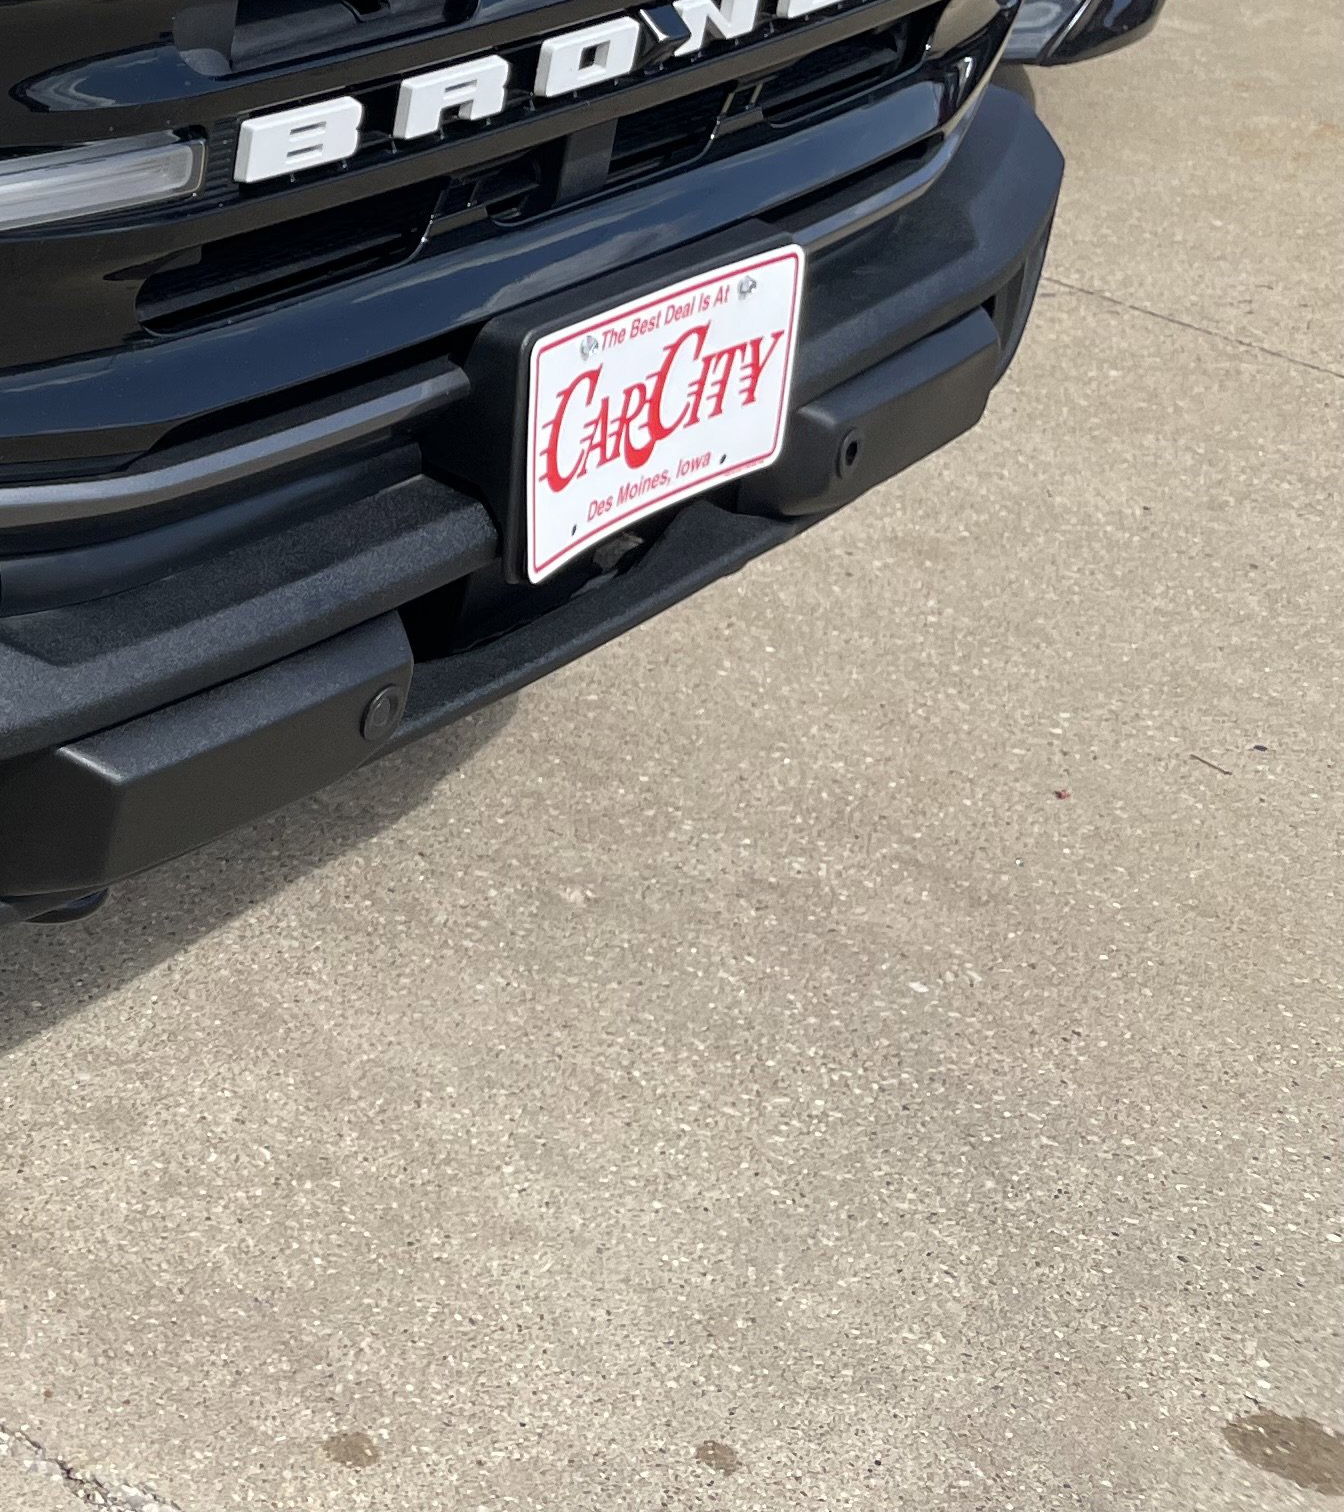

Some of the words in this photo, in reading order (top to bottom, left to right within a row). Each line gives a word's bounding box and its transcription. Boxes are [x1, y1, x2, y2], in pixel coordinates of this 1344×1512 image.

[601, 327, 626, 351] The
[630, 314, 660, 338] Best
[664, 301, 694, 324] Deal
[697, 293, 711, 313] Is
[713, 284, 730, 307] At
[586, 499, 613, 522] Des
[615, 469, 672, 508] Moines,
[675, 451, 712, 480] Iowa
